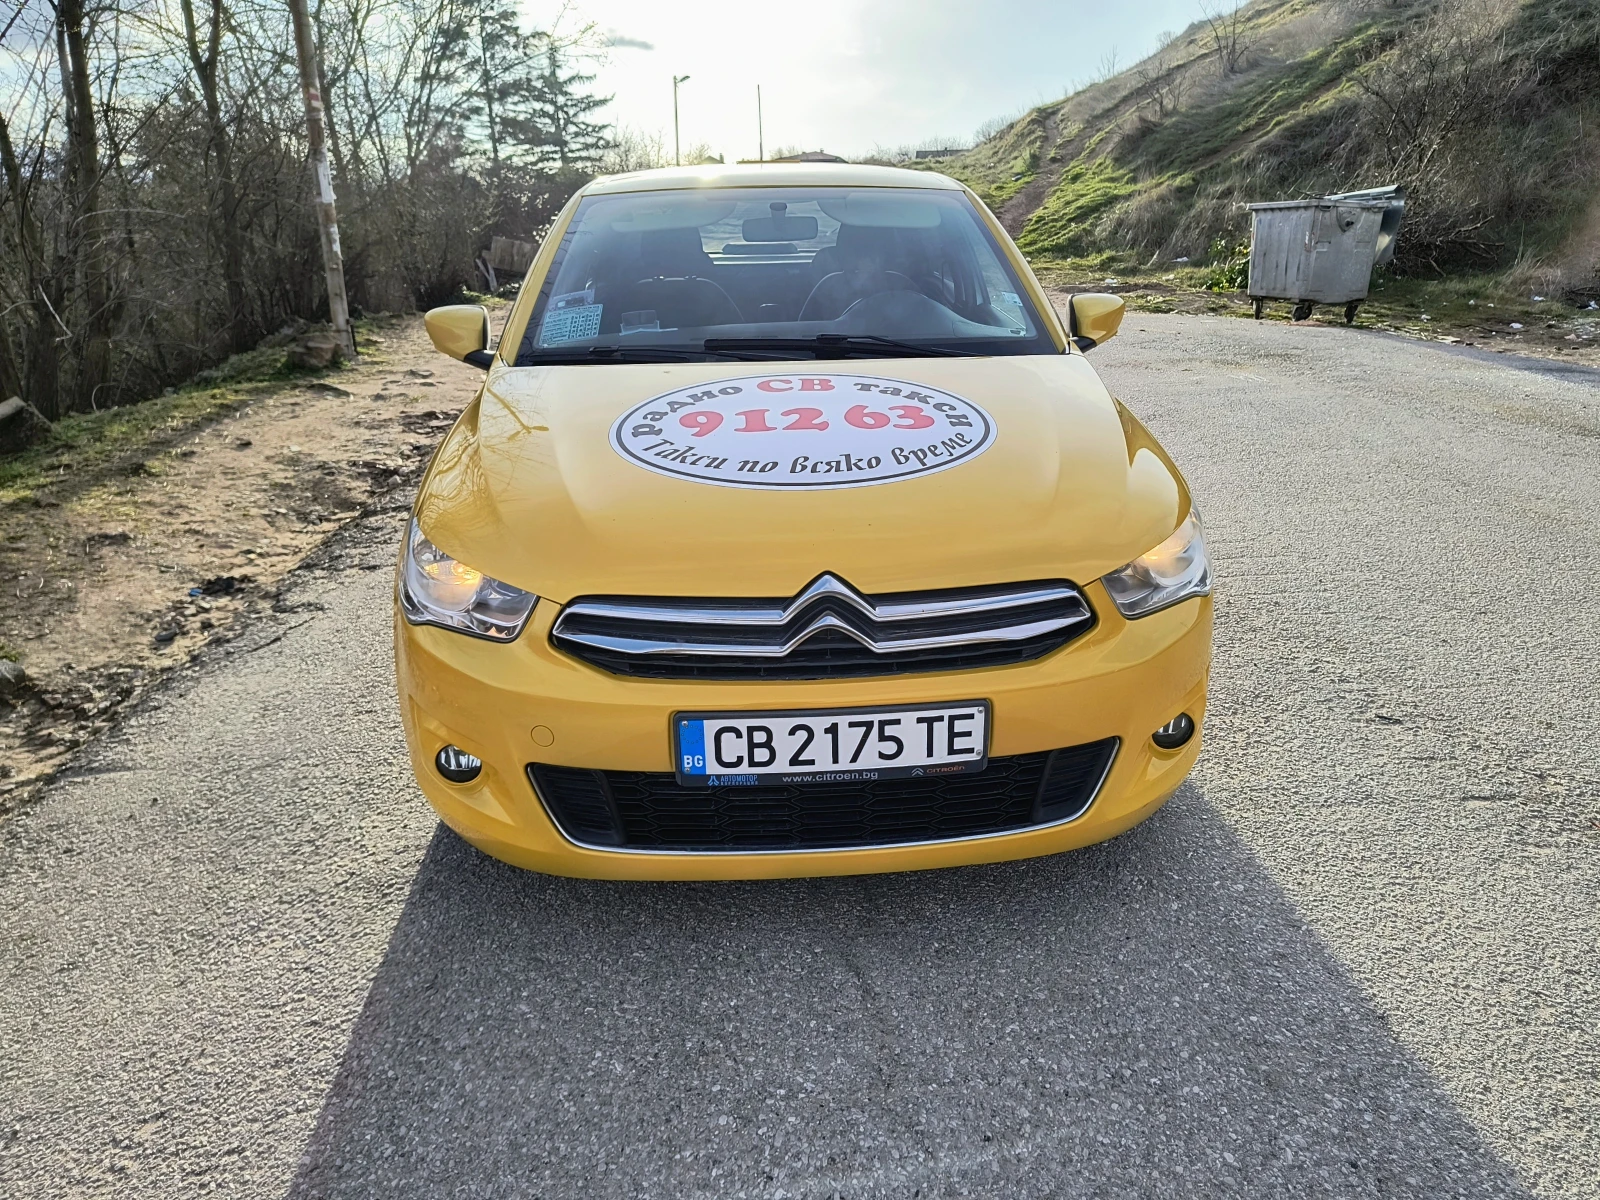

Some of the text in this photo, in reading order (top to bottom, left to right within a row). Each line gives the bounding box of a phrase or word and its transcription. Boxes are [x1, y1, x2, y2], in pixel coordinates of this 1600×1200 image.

[631, 386, 743, 438] радио
[853, 382, 973, 428] такси
[844, 405, 935, 430] 63
[641, 432, 973, 474] Такси по всяко време
[714, 713, 976, 768] CB 2175 TE
[683, 755, 703, 768] BG
[782, 770, 879, 783] www.citroen.bg
